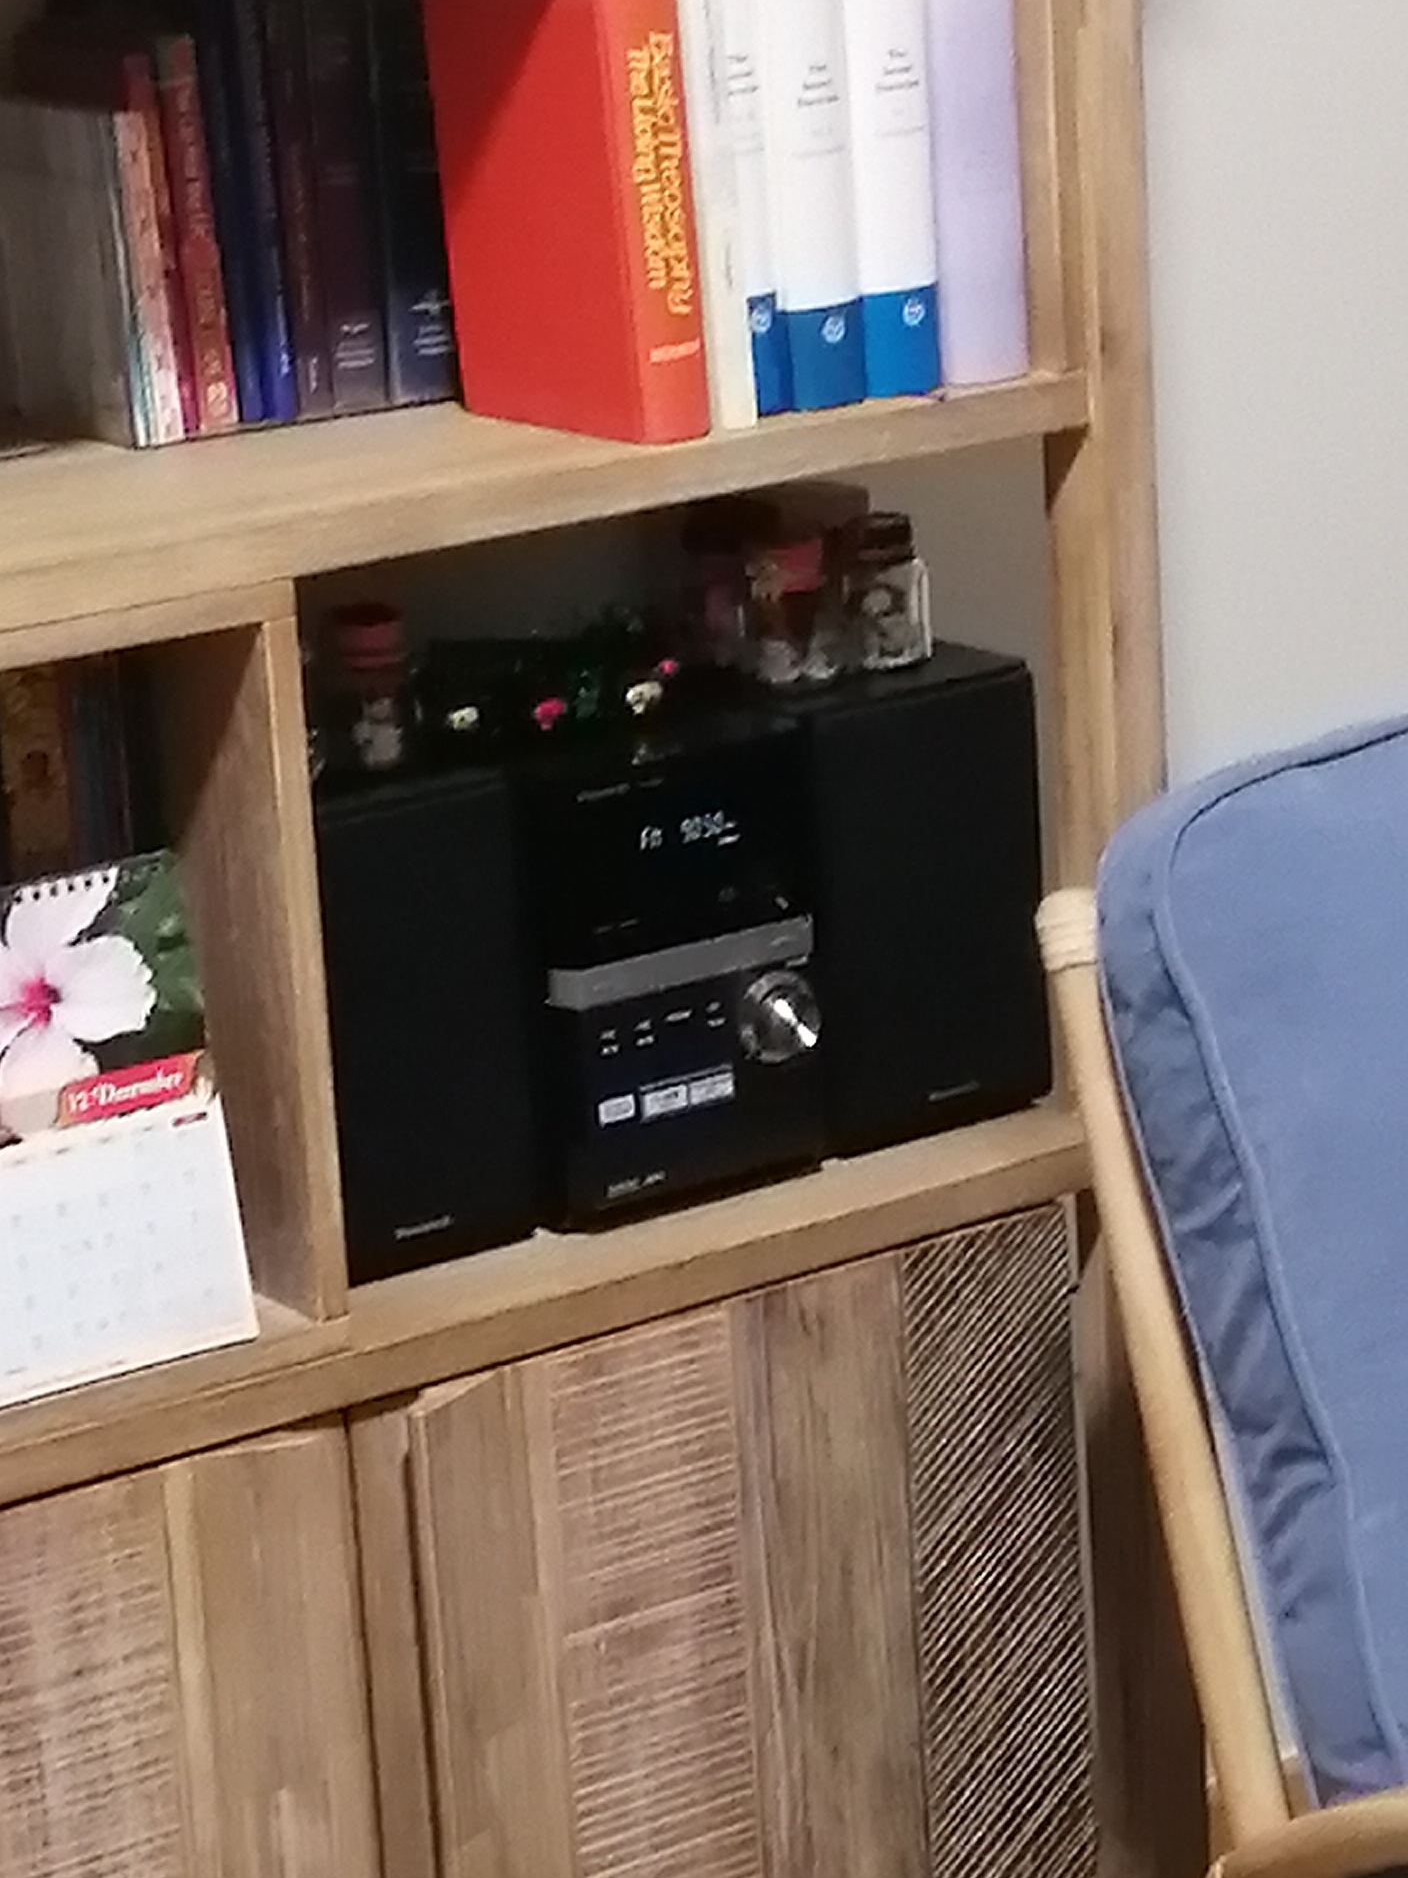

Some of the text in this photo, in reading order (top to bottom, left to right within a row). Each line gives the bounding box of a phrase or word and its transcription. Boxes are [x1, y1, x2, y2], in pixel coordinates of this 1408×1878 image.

[648, 30, 679, 125] Basic
[627, 48, 669, 290] The Living Wisdom
[657, 127, 693, 315] Theosophy
[68, 1091, 90, 1113] 12
